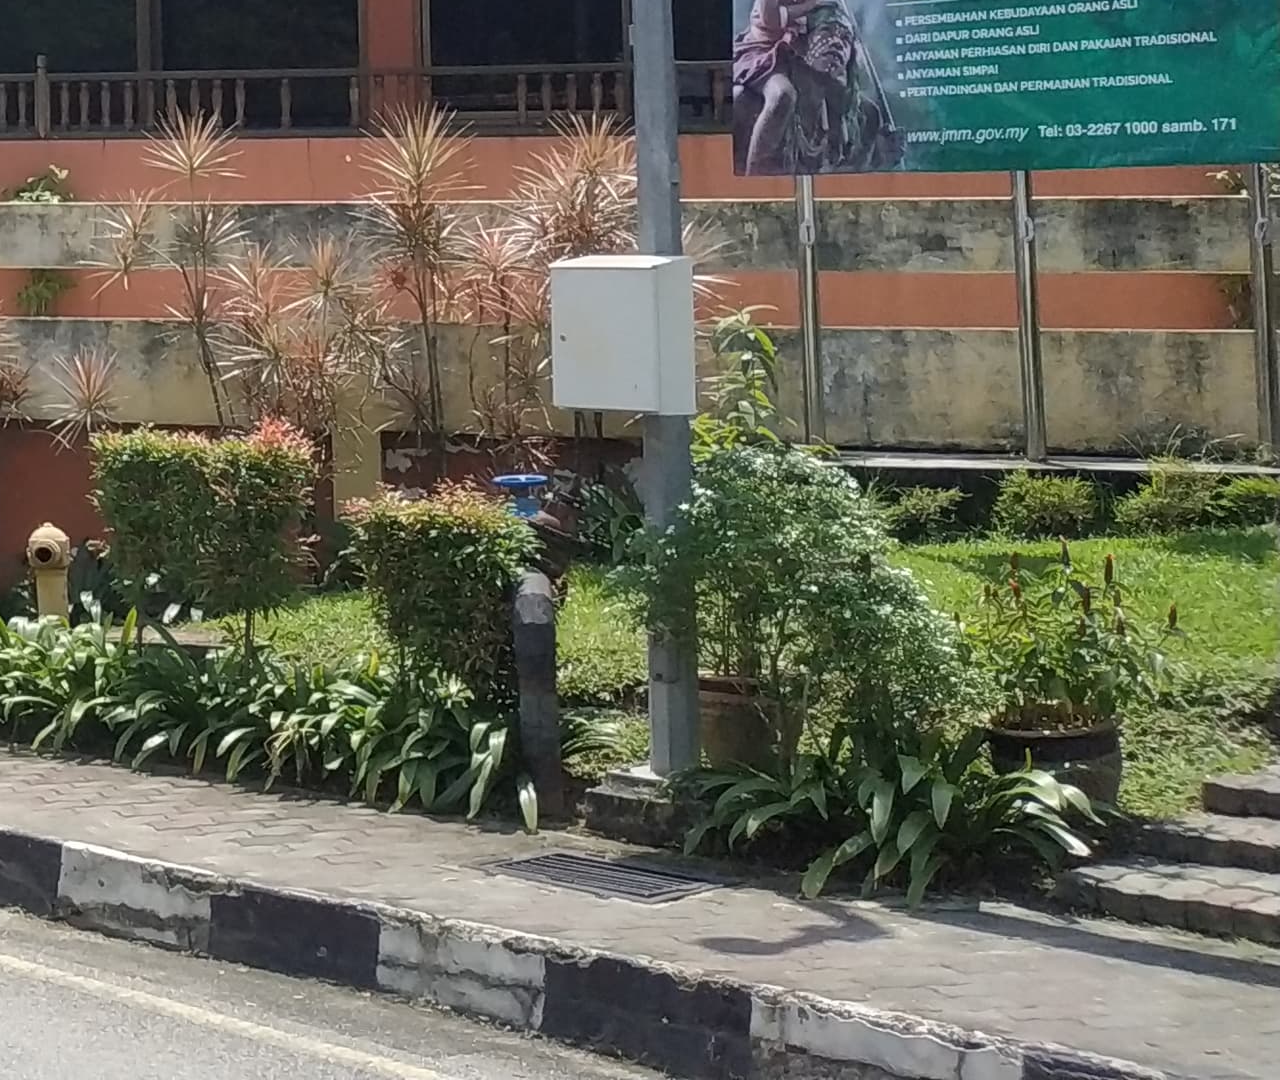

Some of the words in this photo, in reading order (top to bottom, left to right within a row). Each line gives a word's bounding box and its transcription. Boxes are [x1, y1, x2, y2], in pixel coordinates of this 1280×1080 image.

[904, 10, 987, 26] PERSEMBAHAN
[990, 4, 1067, 20] KEBUDAYAAN
[1067, 0, 1110, 14] ORANG
[904, 33, 932, 44] DARI
[933, 30, 970, 42] DAPUR
[971, 27, 1014, 40] ORANG
[1015, 24, 1040, 36] ASLI
[904, 49, 959, 62] ANYAMAN
[961, 44, 1026, 59] PERHIASAN
[1028, 42, 1051, 54] DIRI
[1053, 41, 1078, 52] DAN
[1080, 37, 1132, 50] PAKAIAN
[1133, 31, 1217, 47] TRADISIONAL
[905, 66, 961, 80] ANYAMAN
[963, 64, 999, 77] SIMPAI
[907, 83, 993, 97] PERTANDINGAN
[994, 81, 1018, 93] DAN
[1020, 77, 1090, 92] PERMAINAN
[1091, 73, 1173, 88] TRADISIONAL
[907, 126, 1029, 145] www.jmm.gov.my
[1038, 124, 1063, 137] Tel:
[1065, 122, 1121, 137] 03-2267
[1124, 121, 1158, 134] 1000
[1161, 119, 1208, 133] samb.
[1211, 118, 1237, 131] 171
